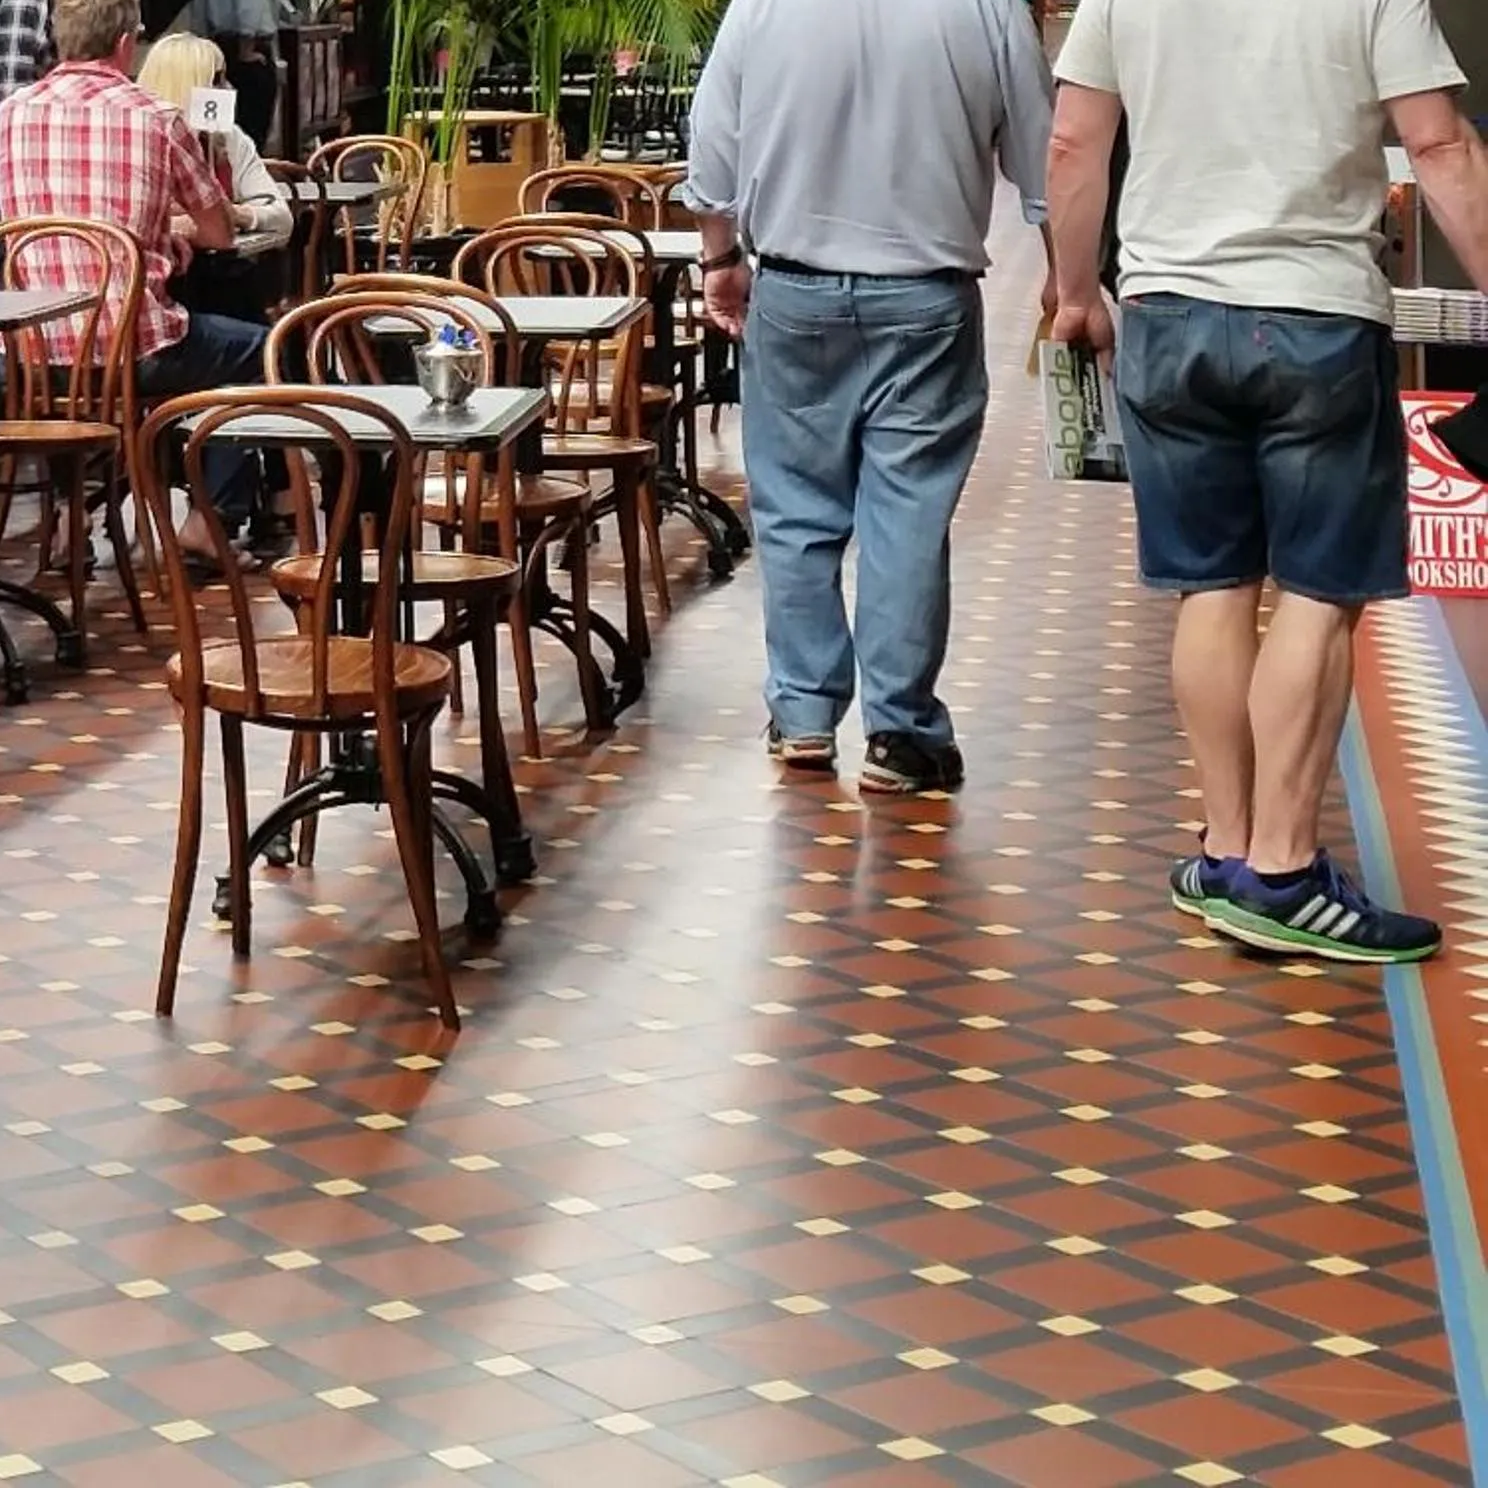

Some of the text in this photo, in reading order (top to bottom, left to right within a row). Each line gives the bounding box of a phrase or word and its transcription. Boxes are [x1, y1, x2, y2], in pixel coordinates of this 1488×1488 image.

[204, 100, 217, 120] 8
[1048, 348, 1084, 478] abode
[1409, 514, 1488, 560] MITH'
[1408, 560, 1488, 590] OKSHO
